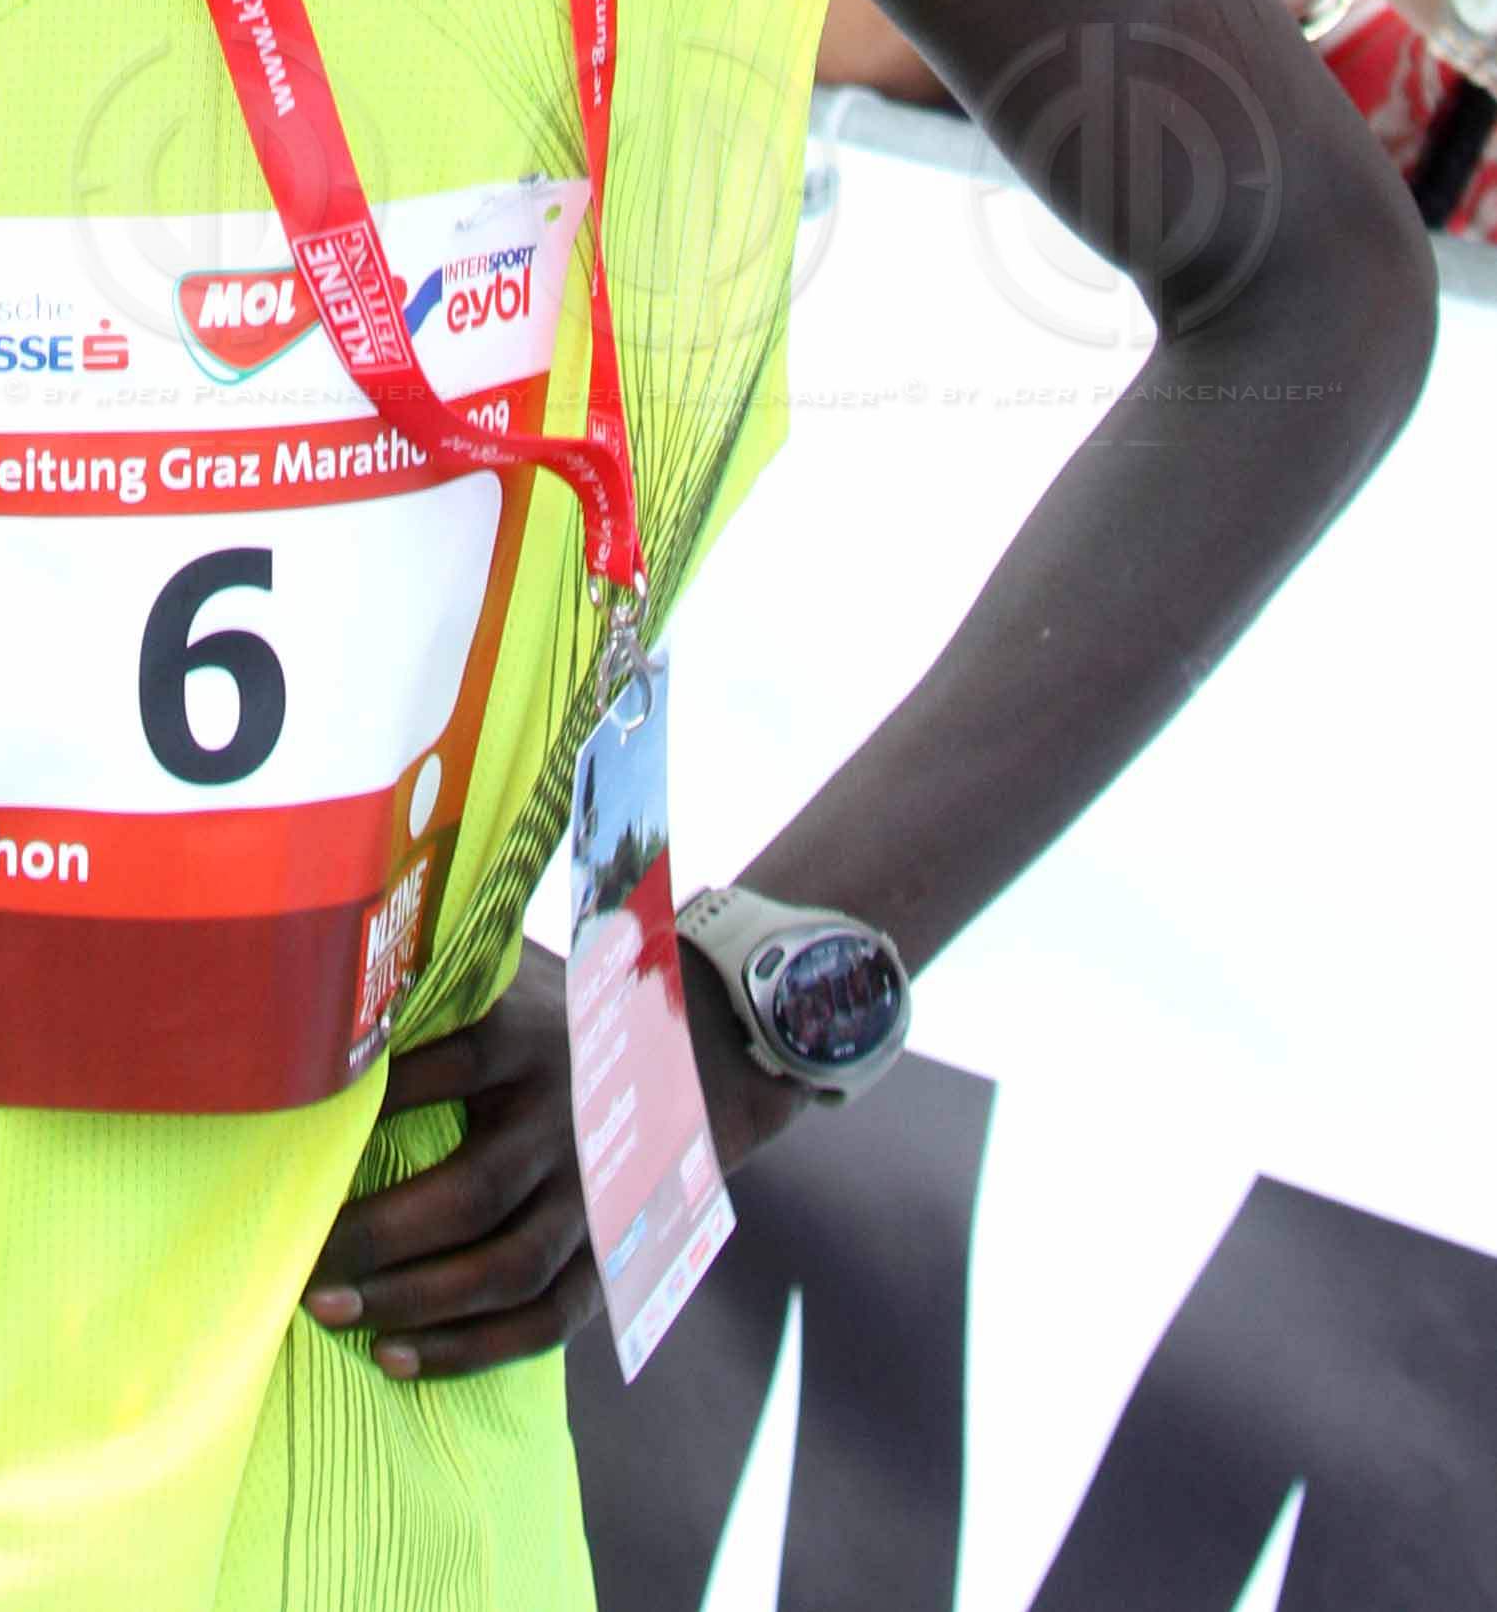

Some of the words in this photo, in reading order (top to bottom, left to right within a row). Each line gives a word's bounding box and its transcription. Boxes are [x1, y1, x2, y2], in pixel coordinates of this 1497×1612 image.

[340, 227, 402, 364] ZEITUNG
[443, 244, 537, 284] INTERSPORT
[198, 279, 297, 330] MOL
[304, 237, 376, 367] KLEINE
[446, 265, 531, 334] eybl
[158, 447, 261, 490] Graz
[272, 428, 431, 484] Maratho
[138, 547, 287, 786] 6
